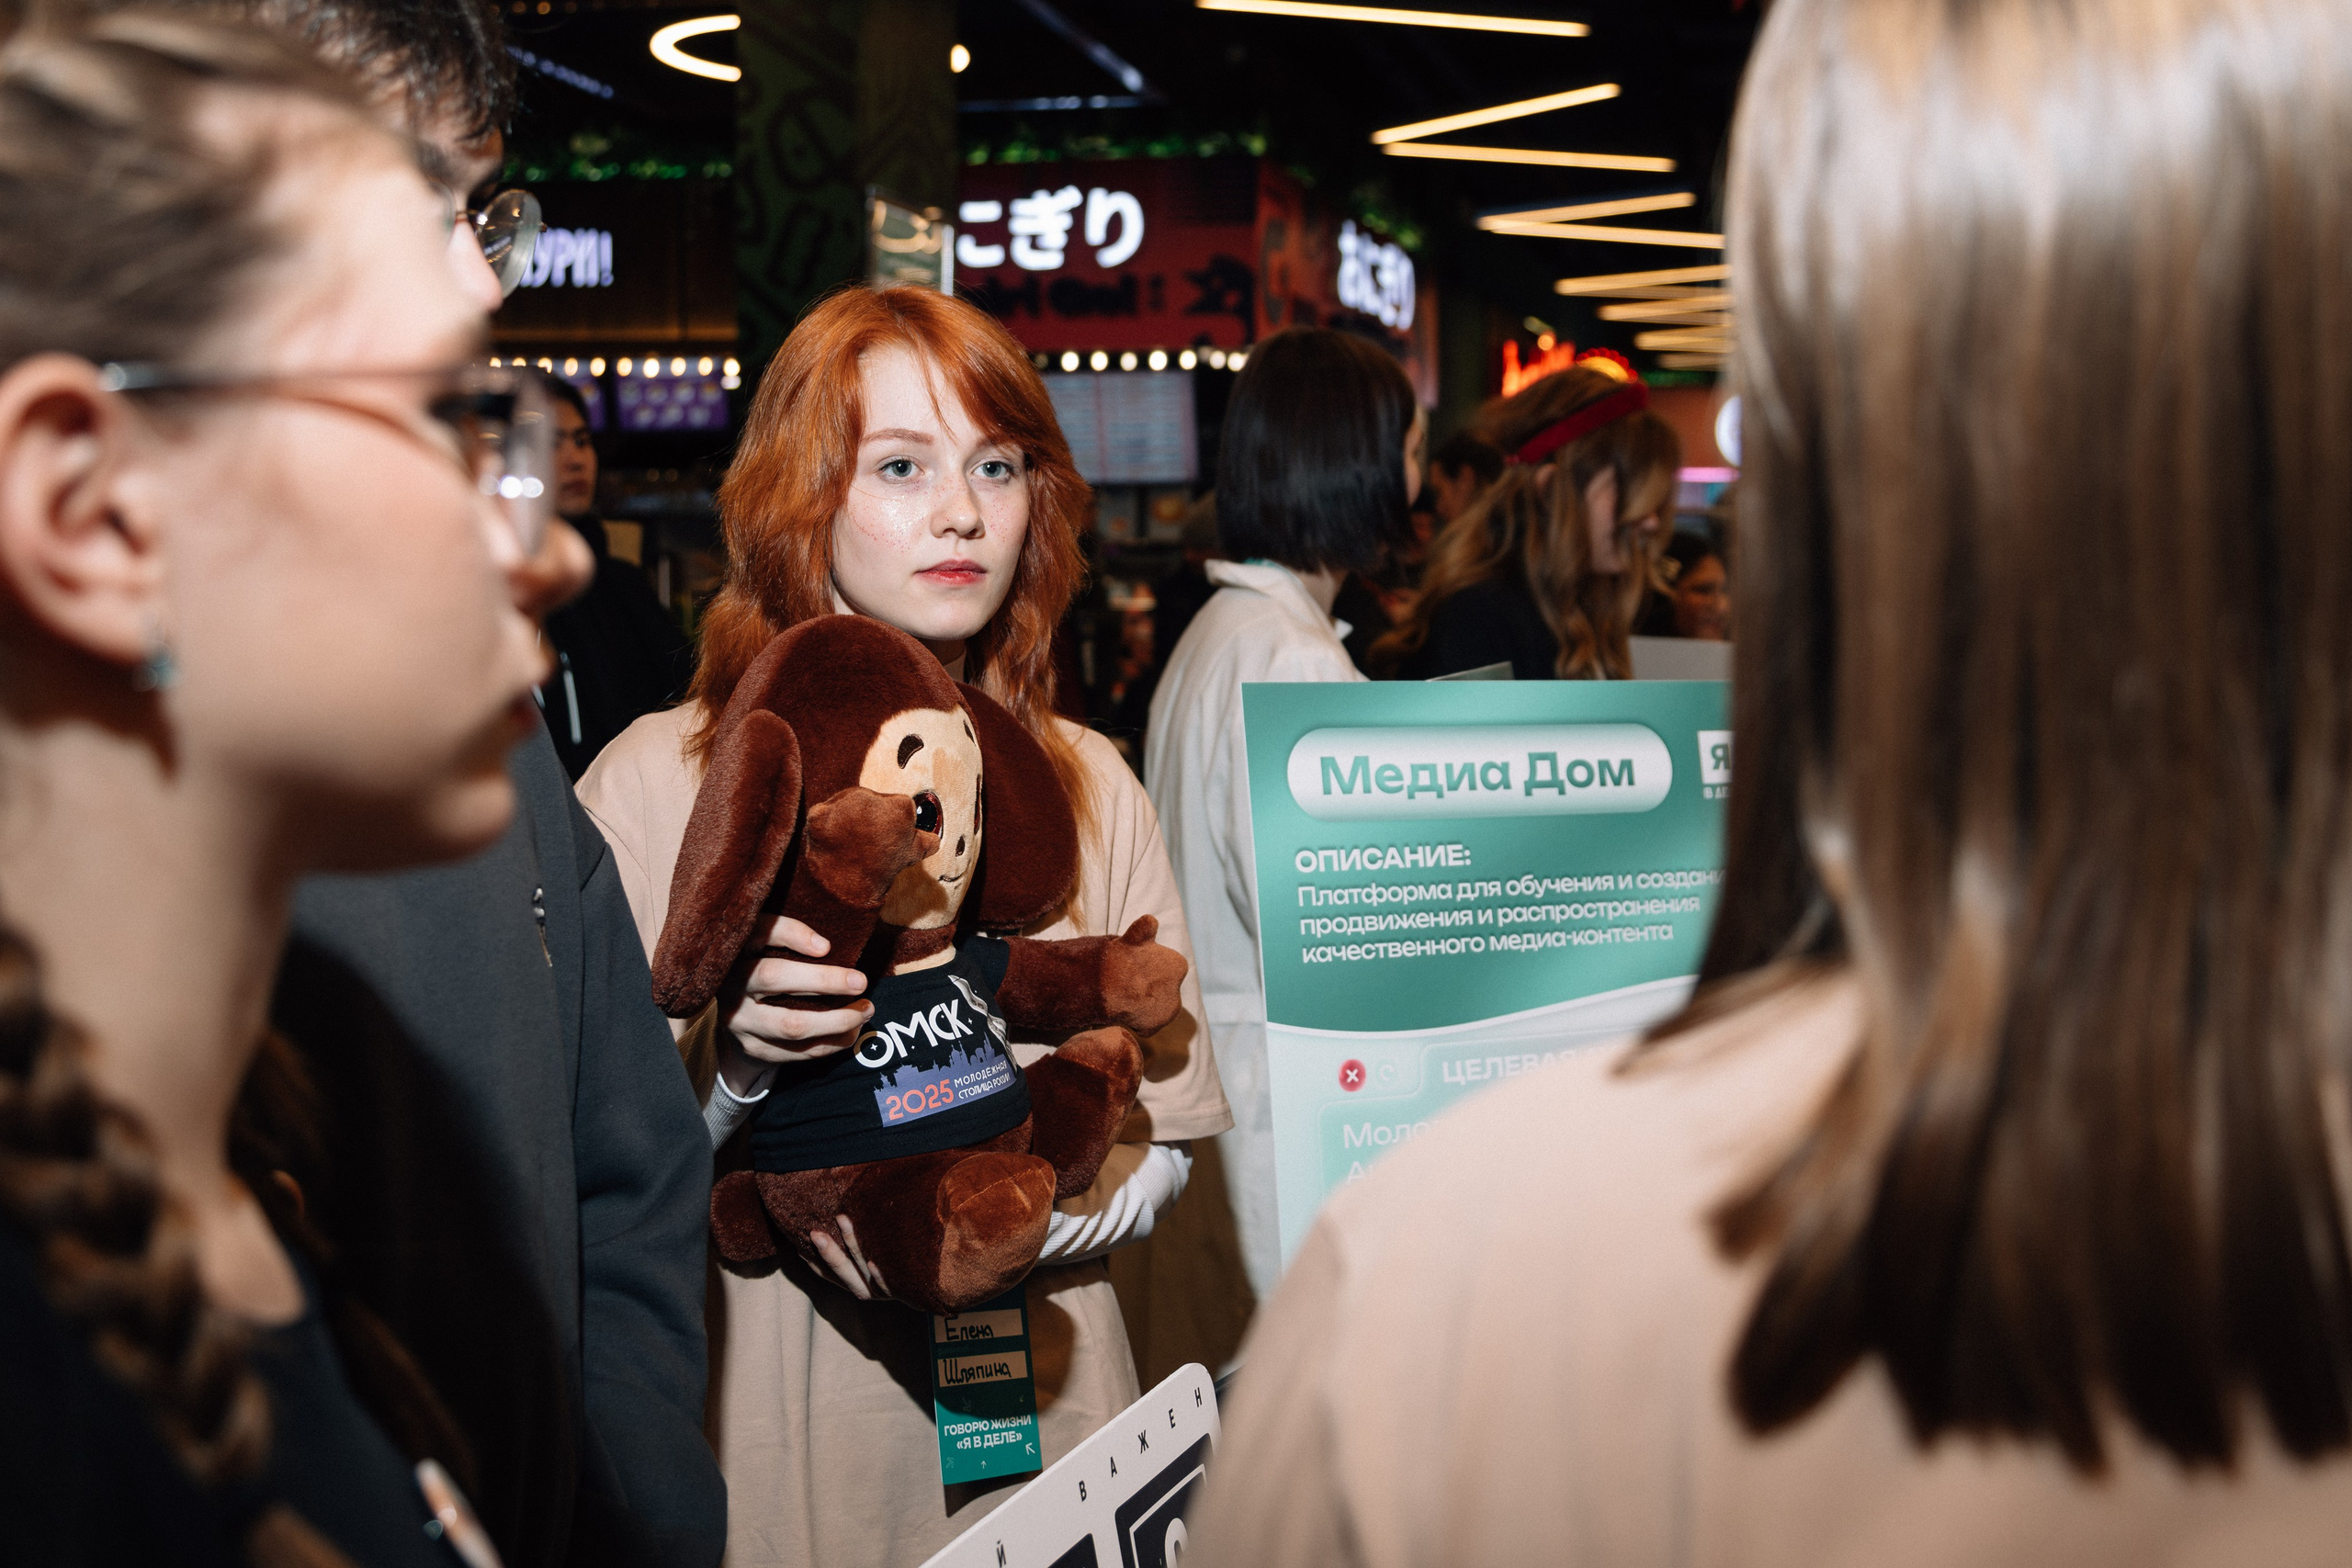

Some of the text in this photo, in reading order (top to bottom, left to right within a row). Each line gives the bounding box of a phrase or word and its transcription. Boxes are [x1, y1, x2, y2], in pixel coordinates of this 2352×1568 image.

[1319, 750, 1636, 801] Медиа Дом
[1295, 843, 1472, 873] ОПИСАНИЕ:
[1297, 869, 1725, 908] Платформа для обучения и создани
[1299, 896, 1701, 939] продвижения и распространения
[1301, 924, 1674, 964] качественного медиа-контента
[853, 998, 974, 1068] ОМСК
[885, 1078, 955, 1121] 2025
[958, 1080, 993, 1100] СТОЛИЦА
[944, 1315, 994, 1341] Елена
[943, 1358, 1012, 1384] Шляпина
[944, 1414, 1032, 1437] ГОВОРЮ ЖИЗНИ
[956, 1430, 1023, 1450] «Я В ДЕЛЕ»
